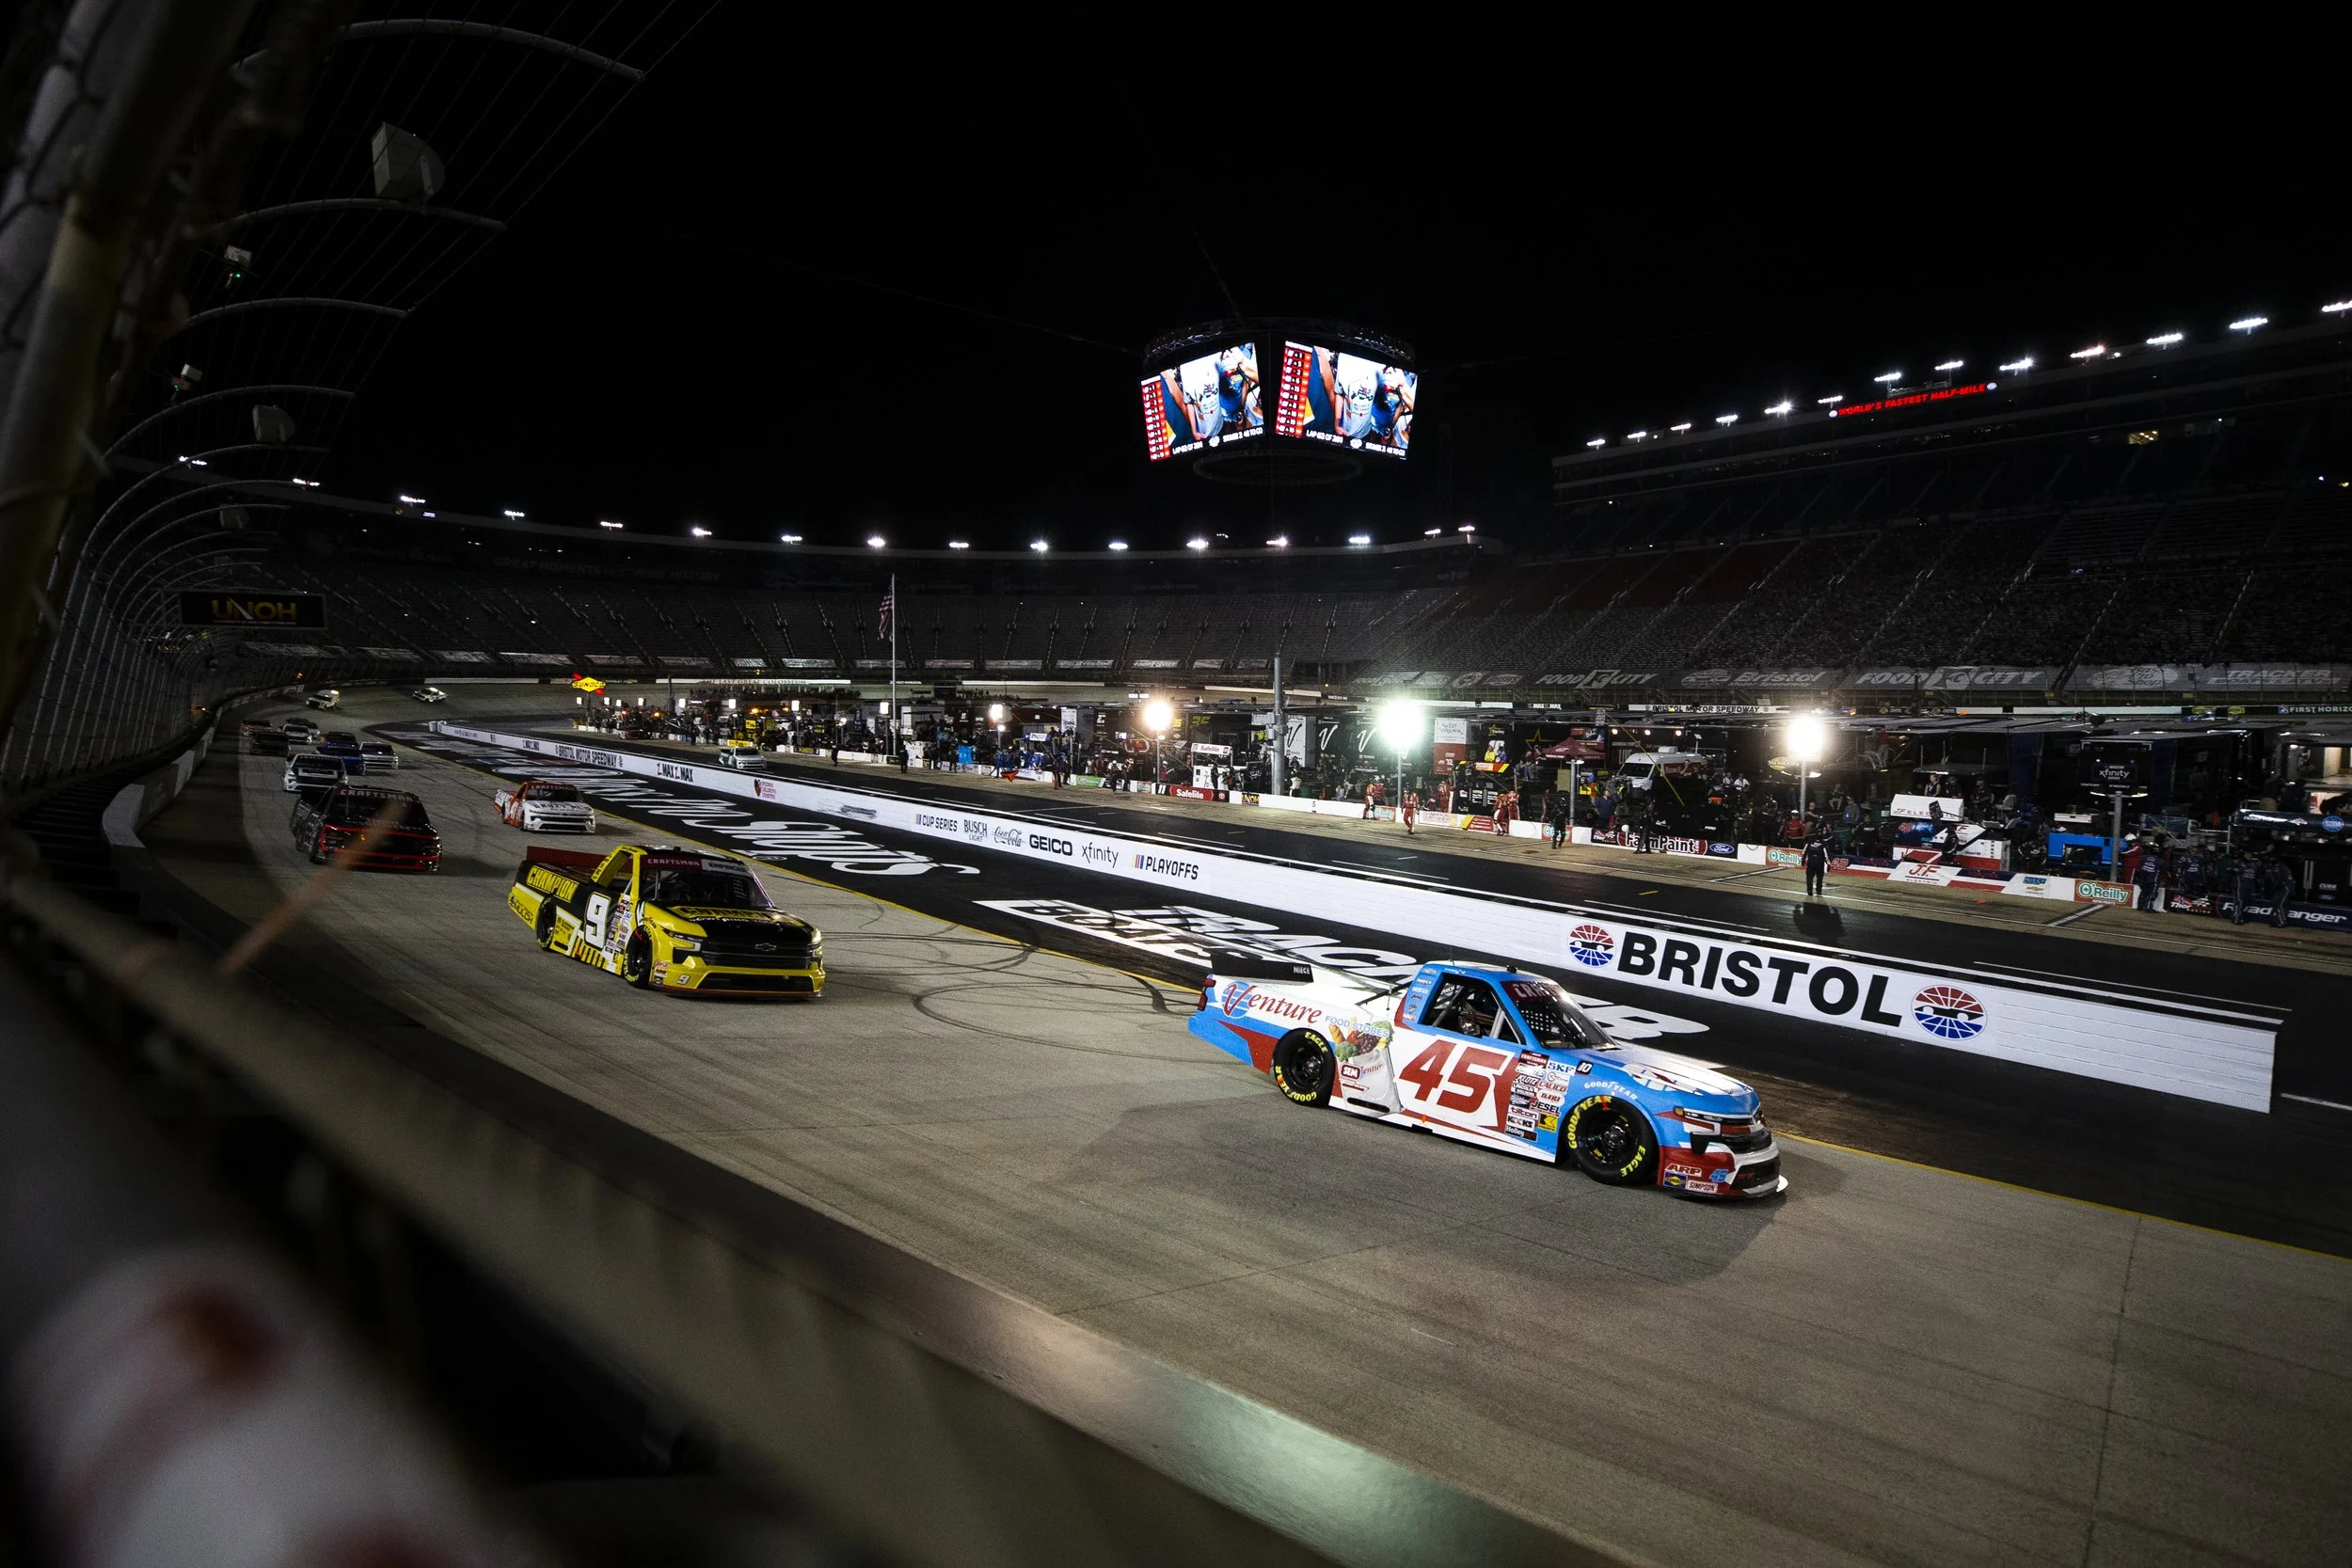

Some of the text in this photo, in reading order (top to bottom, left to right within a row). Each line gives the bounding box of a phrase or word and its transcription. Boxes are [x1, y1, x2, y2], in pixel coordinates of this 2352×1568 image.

[1838, 383, 1987, 416] WORLD'S FASTEST HALF-MILE
[212, 596, 296, 622] UNOH
[573, 681, 605, 689] SUNOCO
[2099, 768, 2130, 779] xfinity
[1176, 788, 1204, 800] Safelite
[1241, 794, 1260, 803] UNOH
[921, 814, 958, 832] CUP SERIES
[963, 819, 988, 836] BUSCH
[1028, 834, 1073, 857] GEICO
[1626, 832, 1695, 854] FamPaint
[1712, 844, 1732, 853] Ford
[647, 858, 701, 866] CRAFTSMAN
[1081, 842, 1120, 868] xfinity
[1769, 849, 1804, 865] O'Reilly
[1145, 856, 1200, 880] PLAYOFFS
[1831, 858, 1849, 870] 42
[527, 865, 580, 903] CHAMPION
[2078, 882, 2129, 902] O'Reilly
[2169, 901, 2192, 910] Thor
[584, 892, 611, 951] 9
[2275, 909, 2348, 923] anger
[1293, 966, 1311, 974] NIECE
[1616, 930, 1903, 1028] BRISTOL
[1222, 981, 1323, 1023] Venture
[1325, 1015, 1390, 1037] FOOD STORES
[1304, 1031, 1328, 1053] EAGLE
[1520, 1053, 1548, 1064] CRAFTSMAN
[1343, 1066, 1359, 1077] SEM
[1548, 1061, 1575, 1073] SKF
[1577, 1061, 1593, 1073] 10
[1399, 1038, 1510, 1115] 45
[1538, 1081, 1567, 1093] CALICO
[1584, 1081, 1637, 1101] GOODYEAR
[1510, 1106, 1537, 1119] tilton
[1532, 1101, 1561, 1114] JESEL
[1566, 1094, 1613, 1150] GOODYEAR
[1505, 1125, 1525, 1137] Holley
[1620, 1144, 1646, 1178] EAGLE
[1667, 1164, 1702, 1177] ARP
[1689, 1181, 1716, 1192] SIMPSON
